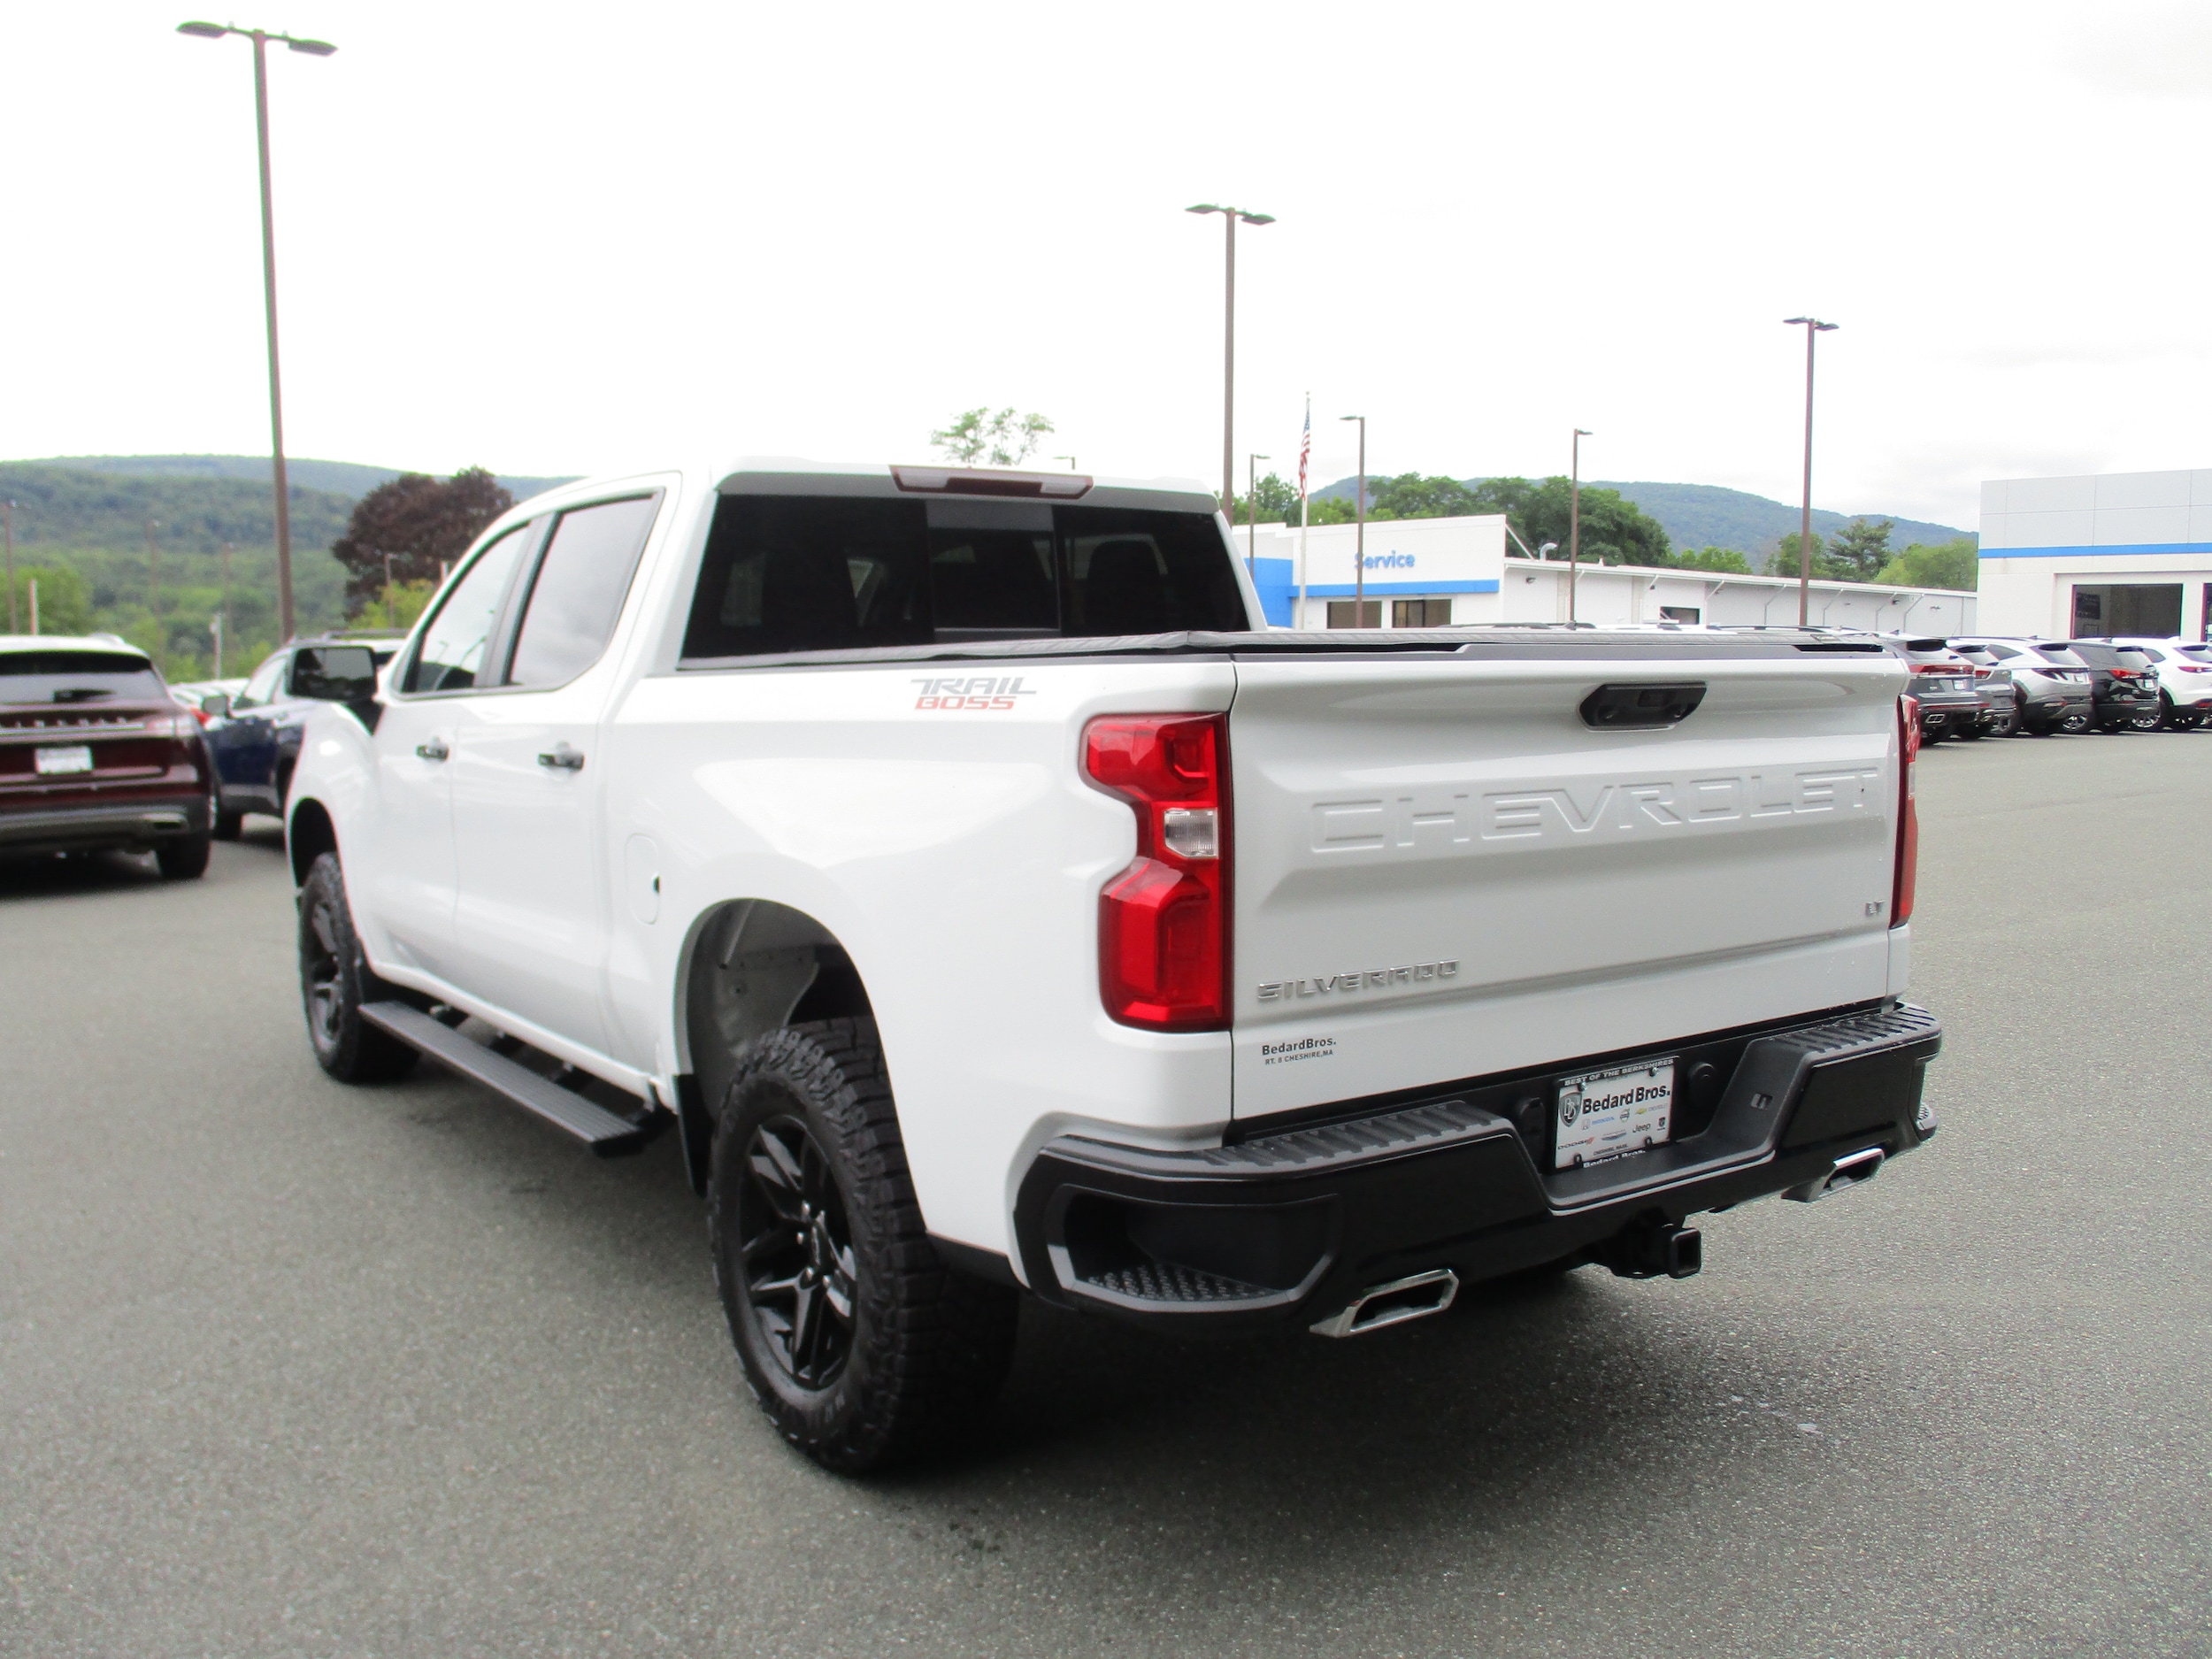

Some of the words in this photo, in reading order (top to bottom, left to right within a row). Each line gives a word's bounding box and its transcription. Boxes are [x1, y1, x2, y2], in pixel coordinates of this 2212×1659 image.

[910, 677, 1037, 695] TRAIL
[915, 695, 1017, 710] BOSS
[1311, 766, 1878, 853] CHEVROLET
[1257, 959, 1460, 999] SILVERADO
[1582, 1088, 1634, 1114] Bedard
[1636, 1084, 1671, 1102] Bros.
